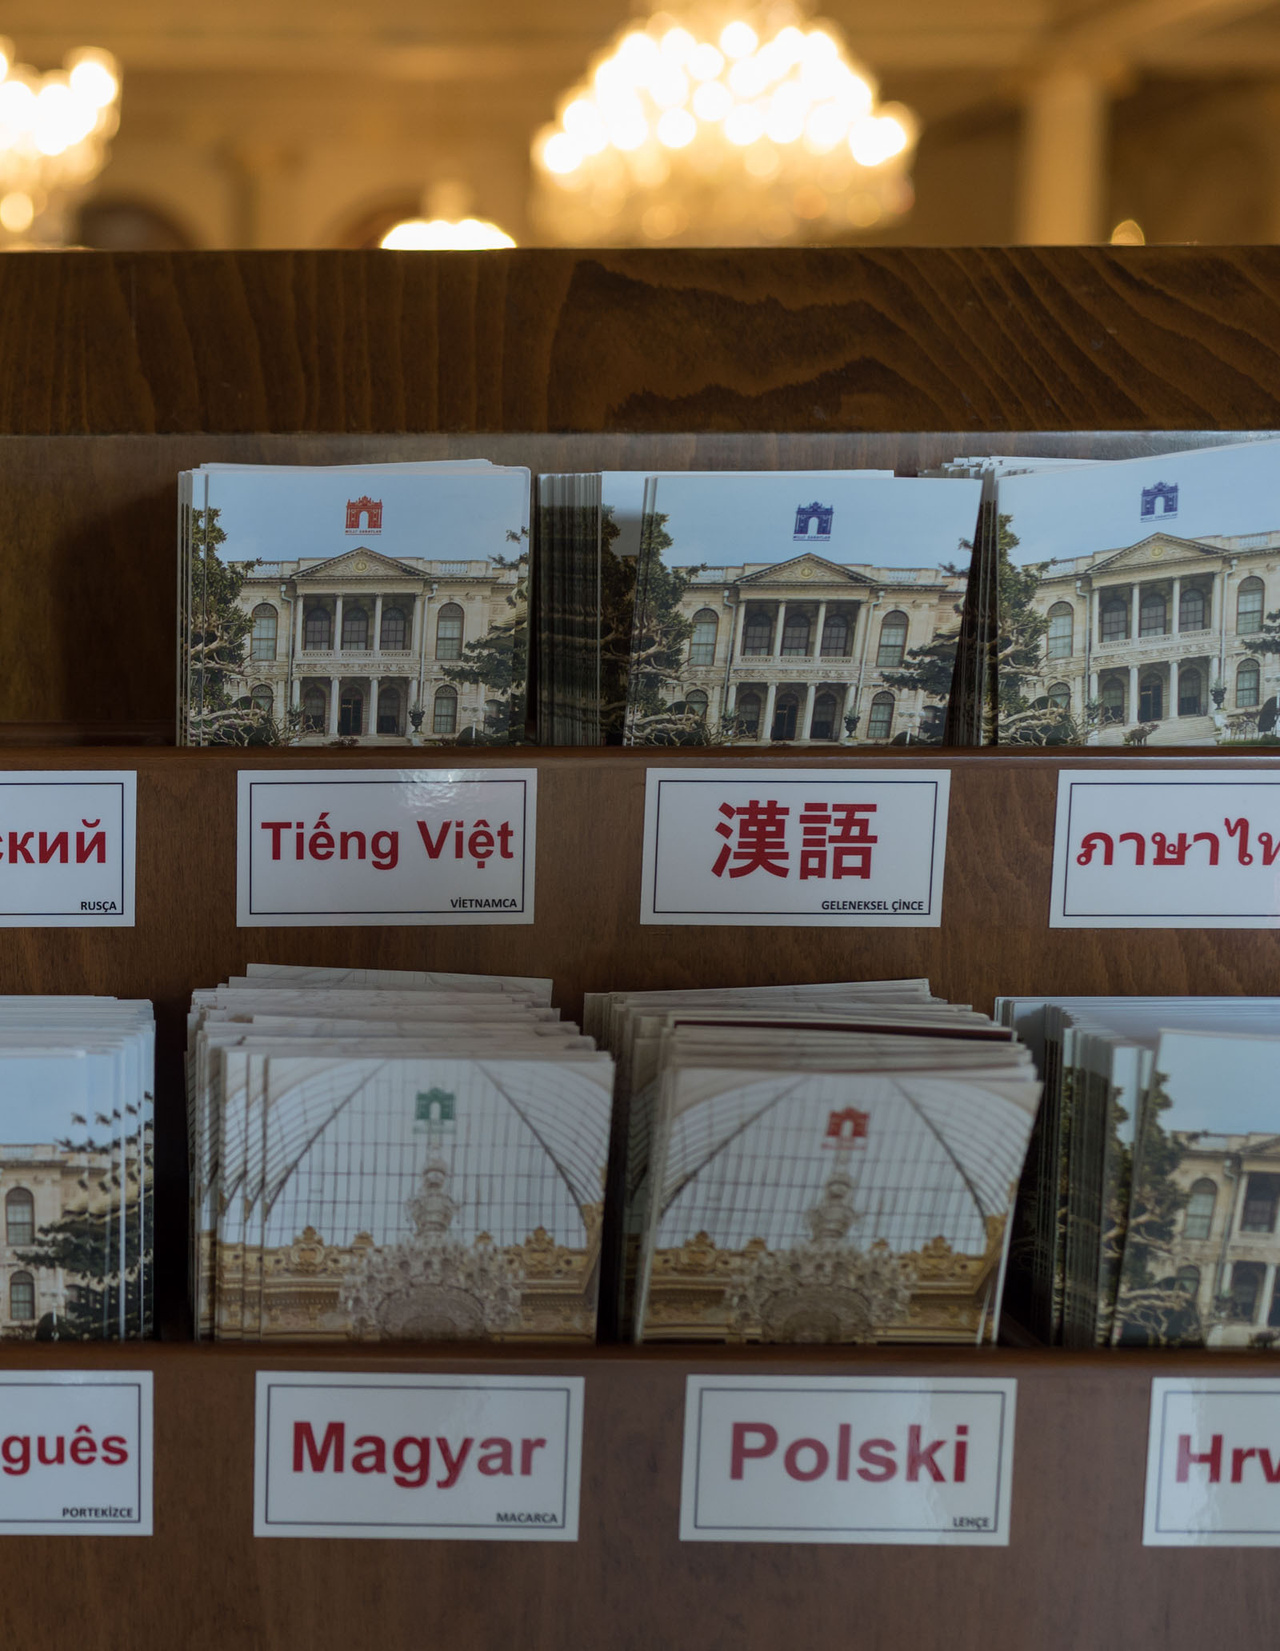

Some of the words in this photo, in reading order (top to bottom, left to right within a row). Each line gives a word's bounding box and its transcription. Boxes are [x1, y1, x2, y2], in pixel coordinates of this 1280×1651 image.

[260, 811, 400, 871] Tiếng
[416, 818, 515, 870] Việt
[711, 799, 879, 880] 漢語
[80, 901, 118, 913] RUSÇA
[821, 900, 889, 911] GELENEKSEL
[890, 899, 925, 912] ÇİNCE
[292, 1421, 547, 1490] Magyar
[729, 1422, 969, 1484] Polski
[496, 1511, 558, 1523] MACARCA
